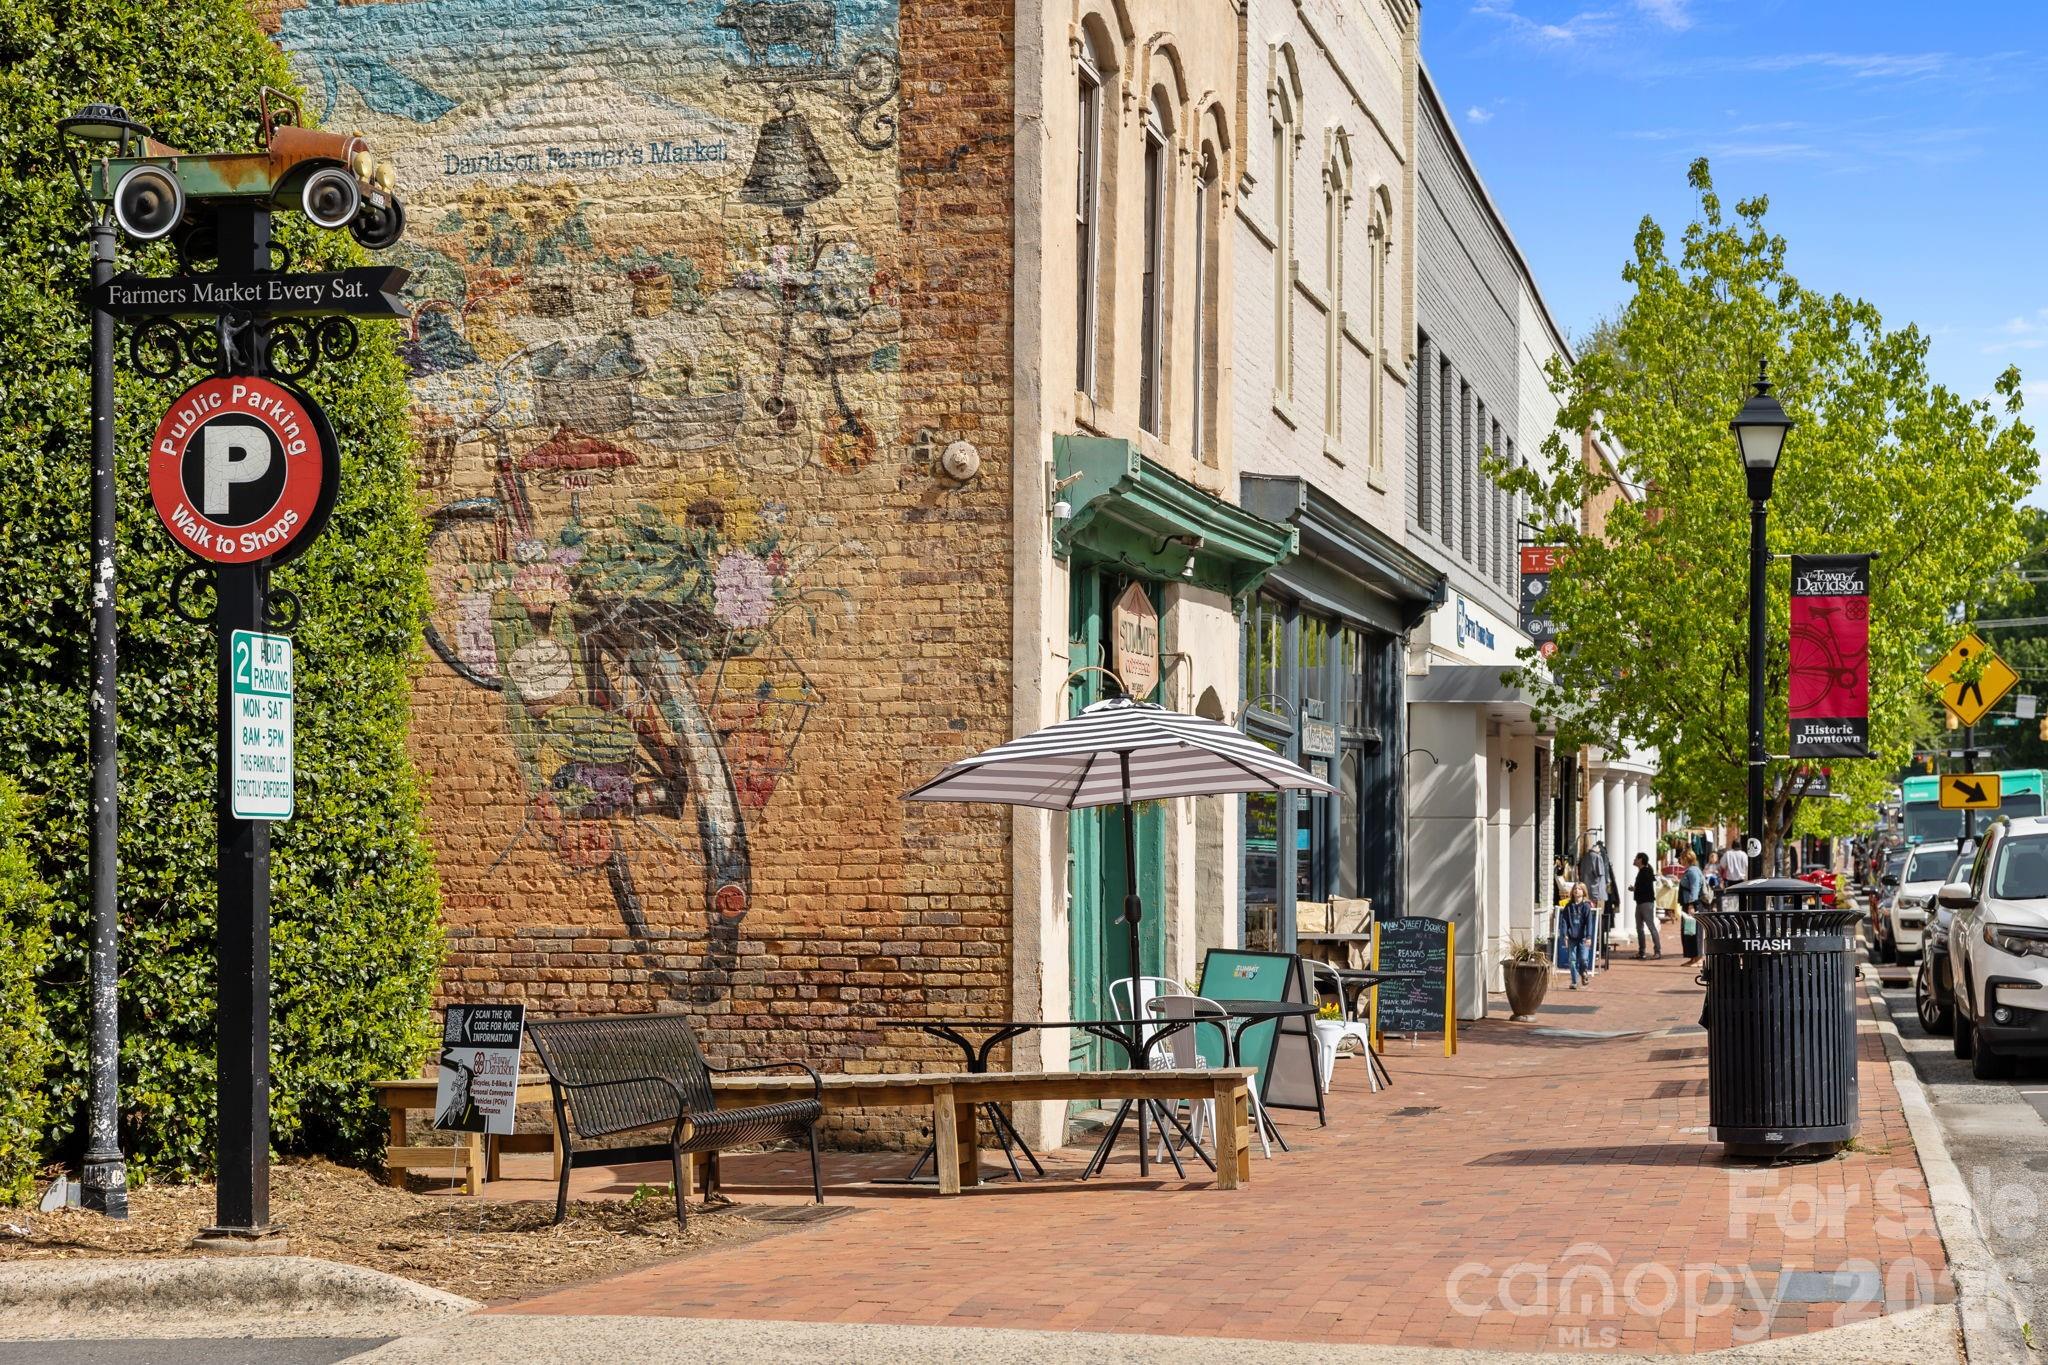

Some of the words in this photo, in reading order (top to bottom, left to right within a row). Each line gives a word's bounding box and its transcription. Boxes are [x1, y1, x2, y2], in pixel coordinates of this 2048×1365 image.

[444, 151, 540, 175] Davidson
[545, 143, 643, 172] Farmer's
[650, 140, 727, 164] Market
[109, 285, 186, 304] Farmers
[193, 283, 262, 302] Market
[268, 280, 325, 304] Every
[332, 278, 369, 298] Sat.
[160, 392, 222, 456] Public
[232, 385, 306, 455] Parking
[204, 426, 271, 514] P
[171, 503, 213, 548] Walk
[216, 535, 236, 554] to
[240, 509, 298, 553] Shops
[1796, 577, 1864, 591] Davidson
[1814, 570, 1845, 581] Town
[1845, 572, 1856, 582] of
[237, 641, 249, 684] 2
[261, 641, 282, 665] HOUR
[254, 668, 288, 691] PARKING
[243, 698, 260, 719] MON
[267, 701, 283, 720] SAT
[243, 727, 260, 746] 8AM
[267, 729, 284, 748] 5PM
[1797, 735, 1860, 744] Downtown
[1805, 725, 1853, 735] Historic
[240, 754, 252, 772] THIS
[253, 755, 275, 773] PARKING
[276, 757, 286, 773] LOT
[236, 779, 261, 798] STRICTLY
[262, 780, 289, 799] ENFORCED
[1400, 919, 1422, 931] STREET
[1424, 920, 1446, 933] BOOKS
[1398, 949, 1425, 957] REASONS
[1742, 939, 1792, 950] TRASH
[475, 1010, 490, 1019] SCAN
[492, 1010, 502, 1019] THE
[504, 1010, 512, 1021] QR
[1416, 1020, 1425, 1028] 25
[473, 1021, 490, 1030] CODE
[490, 1021, 502, 1030] FOR
[503, 1021, 520, 1030] MORE
[472, 1033, 513, 1042] INFORMATION
